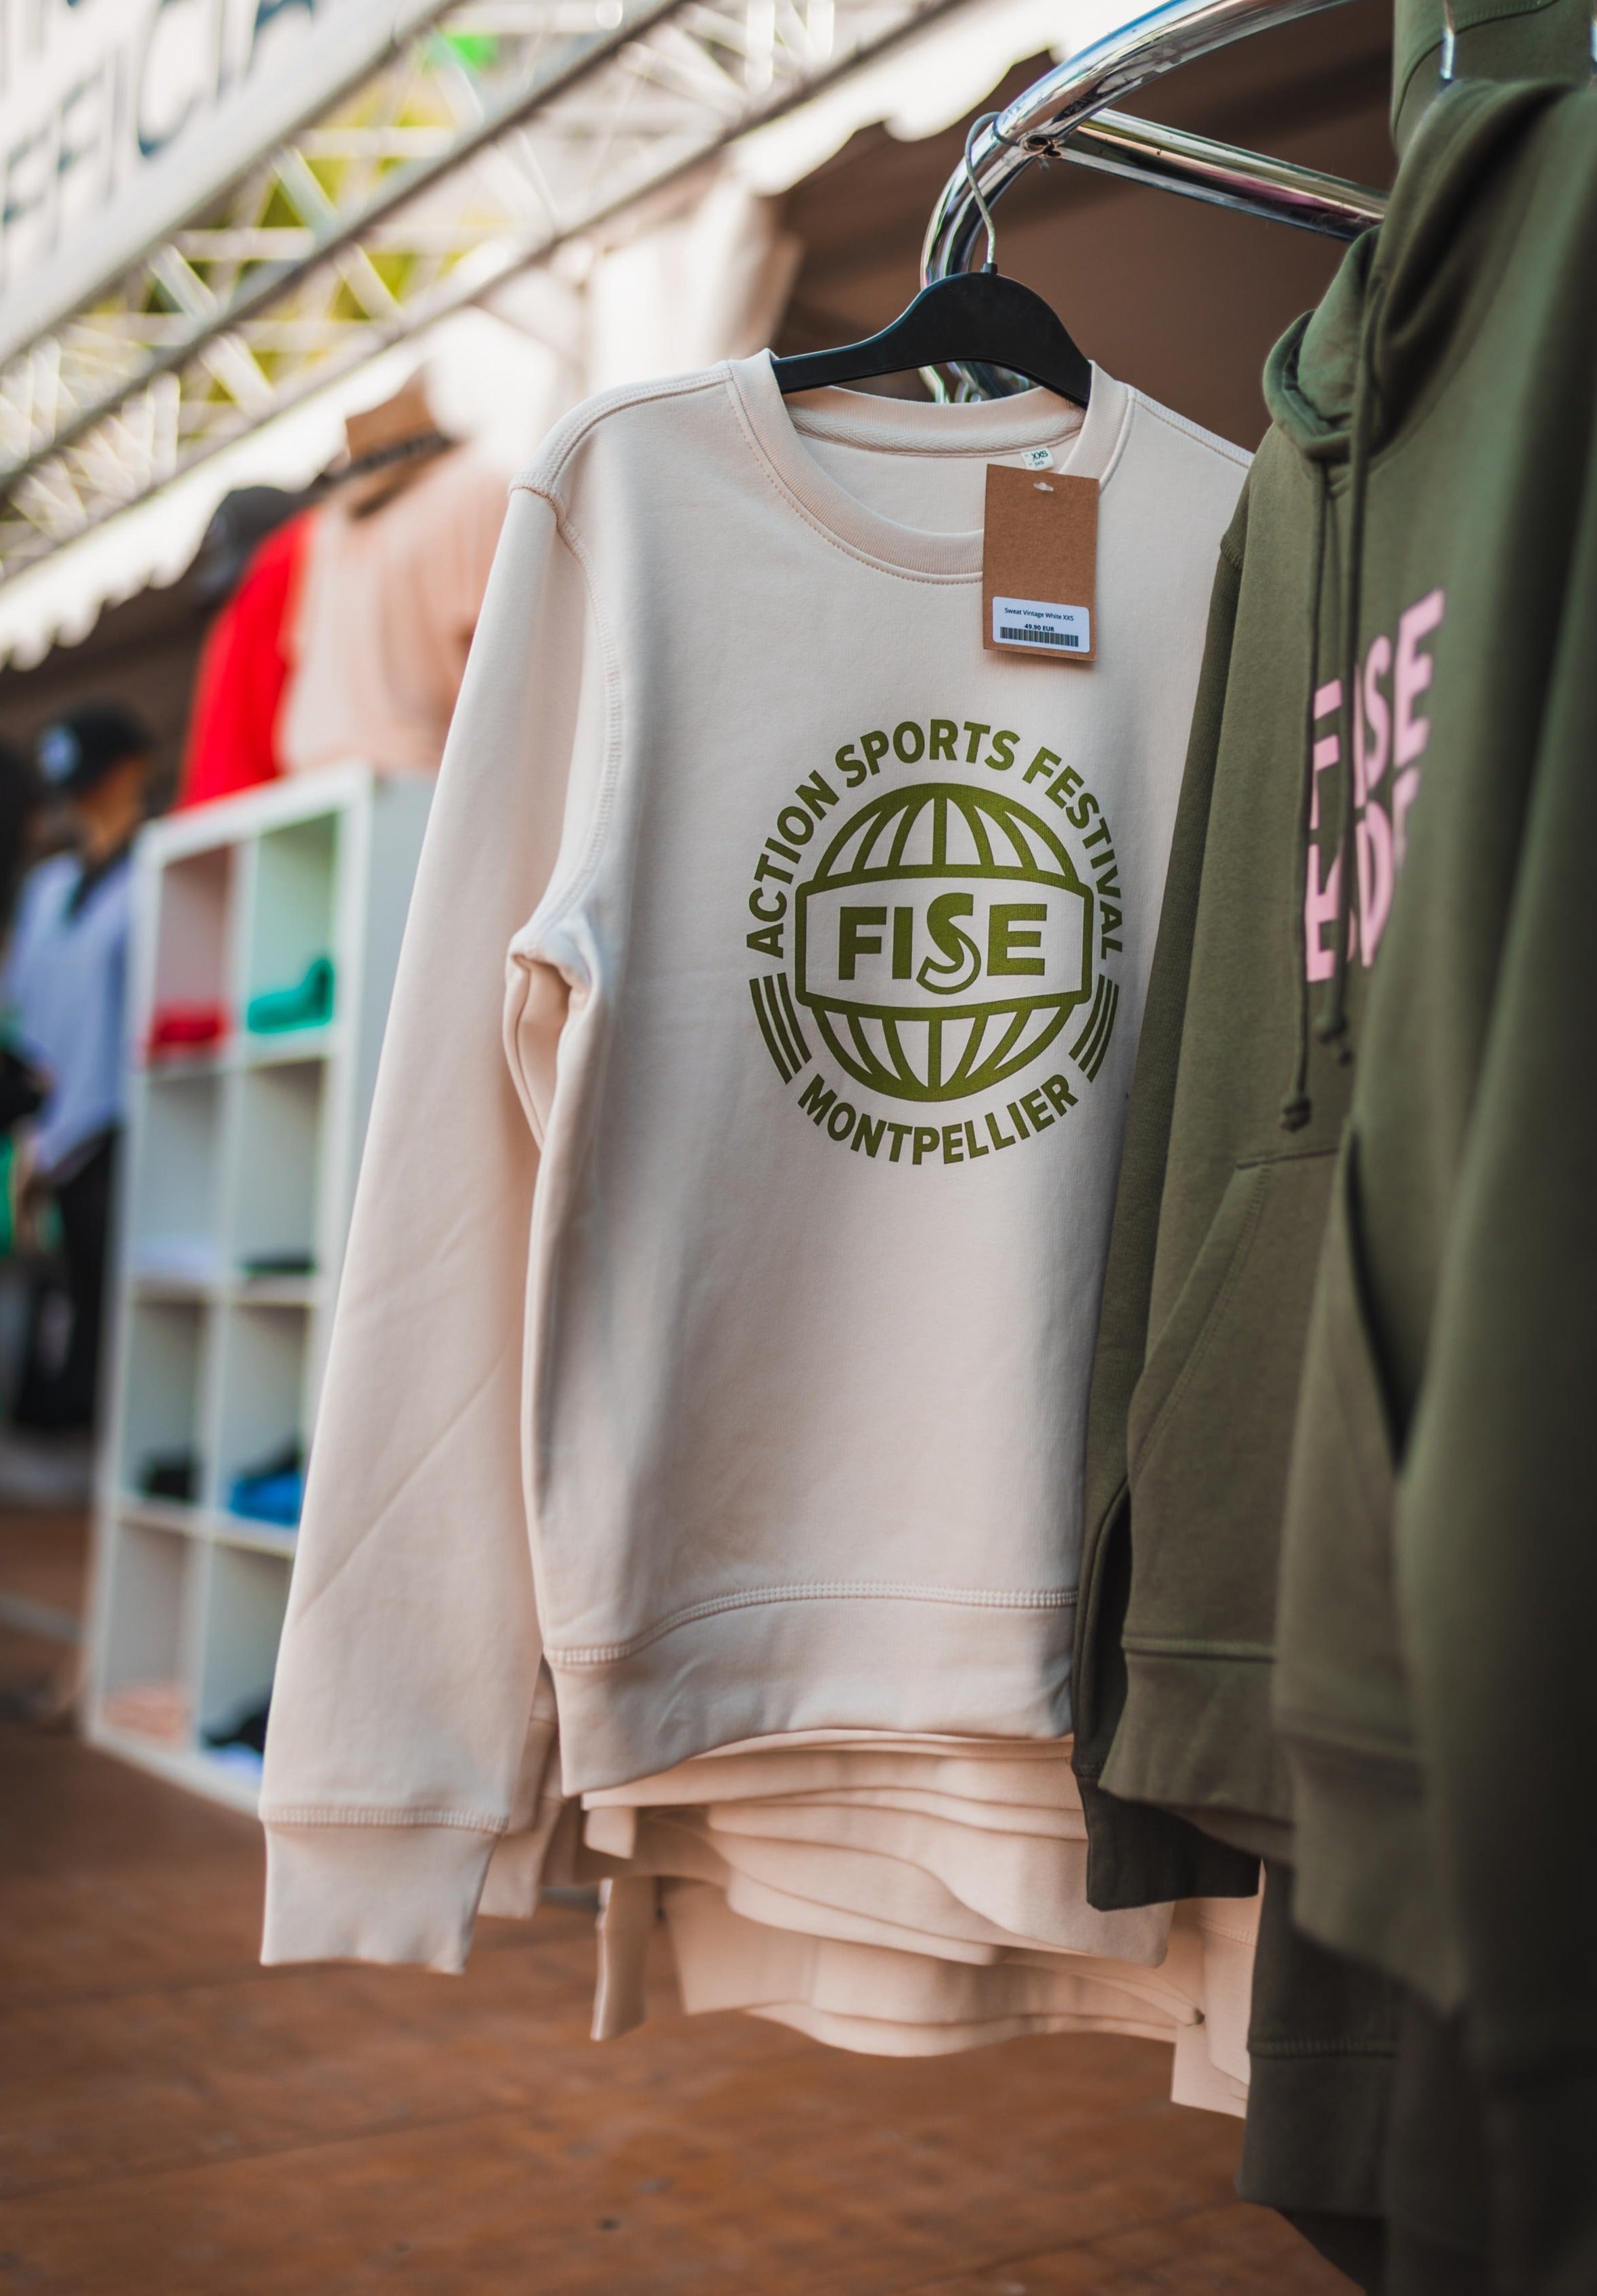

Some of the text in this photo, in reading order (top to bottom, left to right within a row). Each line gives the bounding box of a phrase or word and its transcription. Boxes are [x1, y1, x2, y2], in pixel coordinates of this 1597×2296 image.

[1031, 450, 1048, 460] XXS
[1023, 610, 1044, 618] Vintage
[746, 770, 840, 959] ACTION
[835, 719, 1020, 788] SPORTS
[1022, 746, 1123, 960] FESTIVAL
[838, 893, 1048, 995] FISE
[798, 1073, 1079, 1165] MONTPELLIER
